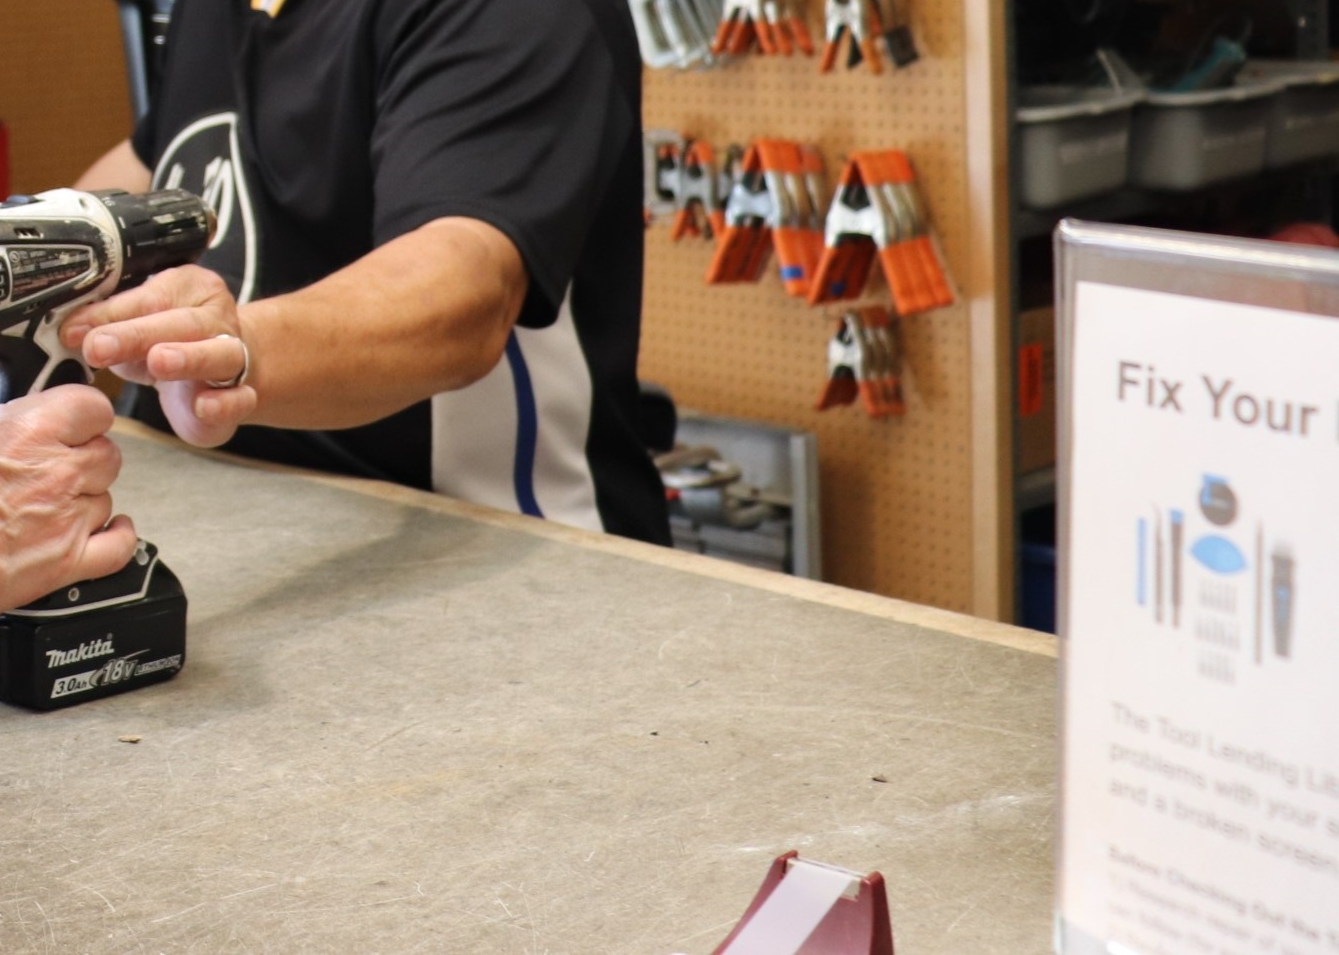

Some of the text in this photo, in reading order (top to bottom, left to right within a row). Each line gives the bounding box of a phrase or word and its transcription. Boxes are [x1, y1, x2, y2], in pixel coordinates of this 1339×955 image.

[1116, 359, 1319, 436] Fix Your
[101, 658, 138, 686] 18V
[1110, 700, 1150, 733] The
[1156, 715, 1201, 750] Tool
[1206, 733, 1300, 789] Lending
[1109, 742, 1207, 790] problems
[1266, 798, 1318, 829] your
[1109, 778, 1148, 807] and
[1153, 793, 1168, 814] a
[1173, 798, 1250, 844] broken
